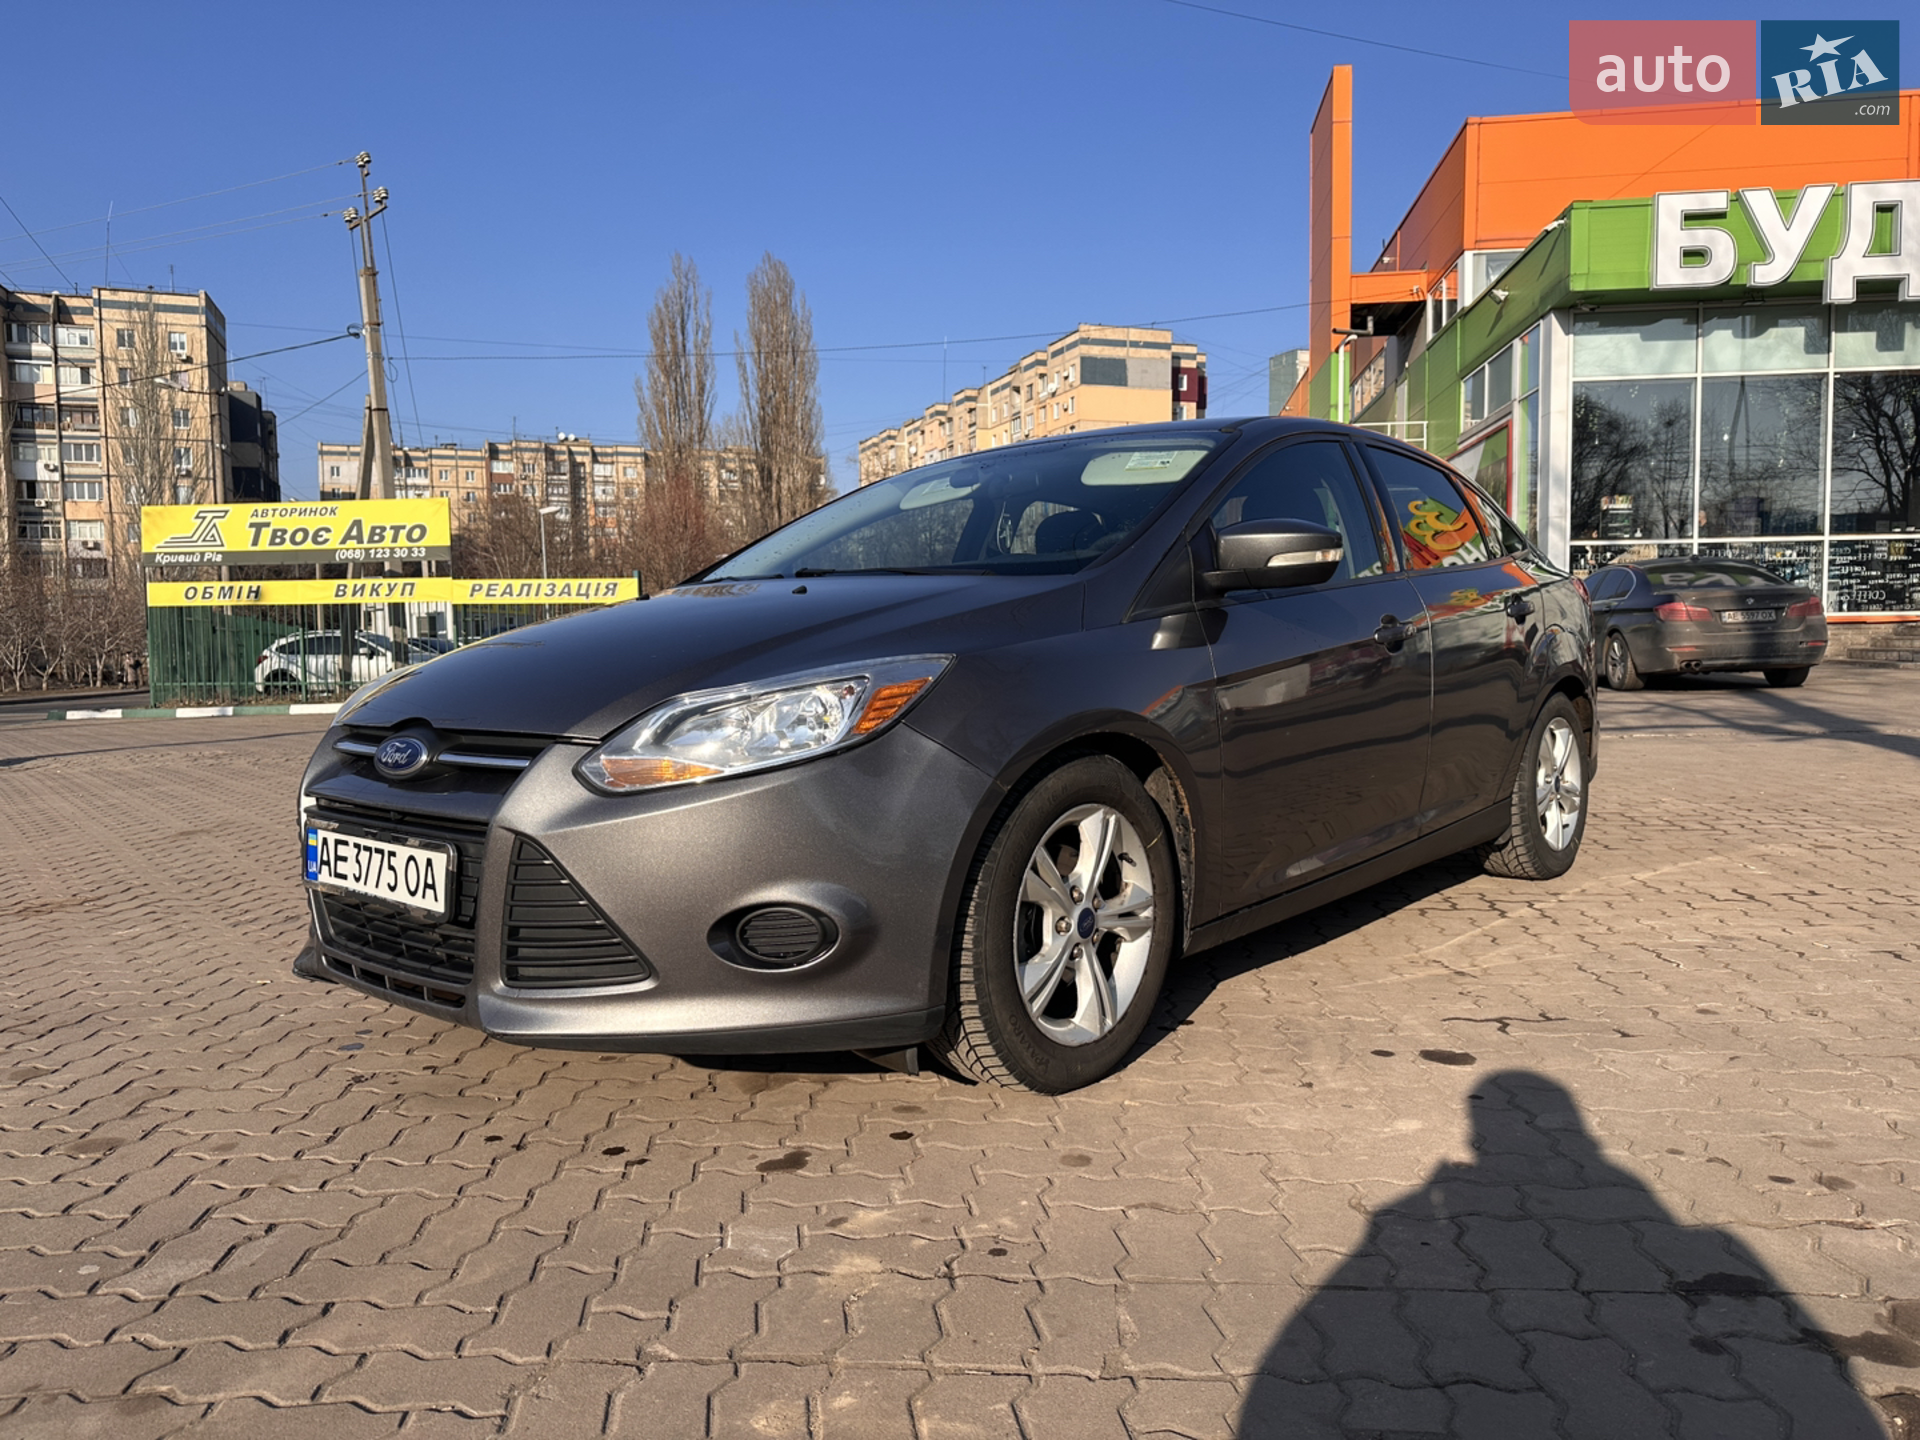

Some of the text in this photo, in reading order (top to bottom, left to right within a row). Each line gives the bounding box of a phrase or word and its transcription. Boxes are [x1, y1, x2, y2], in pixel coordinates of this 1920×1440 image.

[1649, 179, 1920, 304] БУД
[250, 506, 339, 518] АВТОРИНОК
[155, 551, 223, 564] Кривий Ріг
[335, 547, 426, 561] (068) 123 30 33
[184, 585, 262, 600] ОБМІН
[334, 582, 416, 598] ВИКУП
[469, 582, 619, 599] РЕАЛІЗАЦІЯ
[381, 741, 412, 766] Ford
[307, 859, 318, 873] UA
[319, 836, 439, 903] AE 3775 OA
